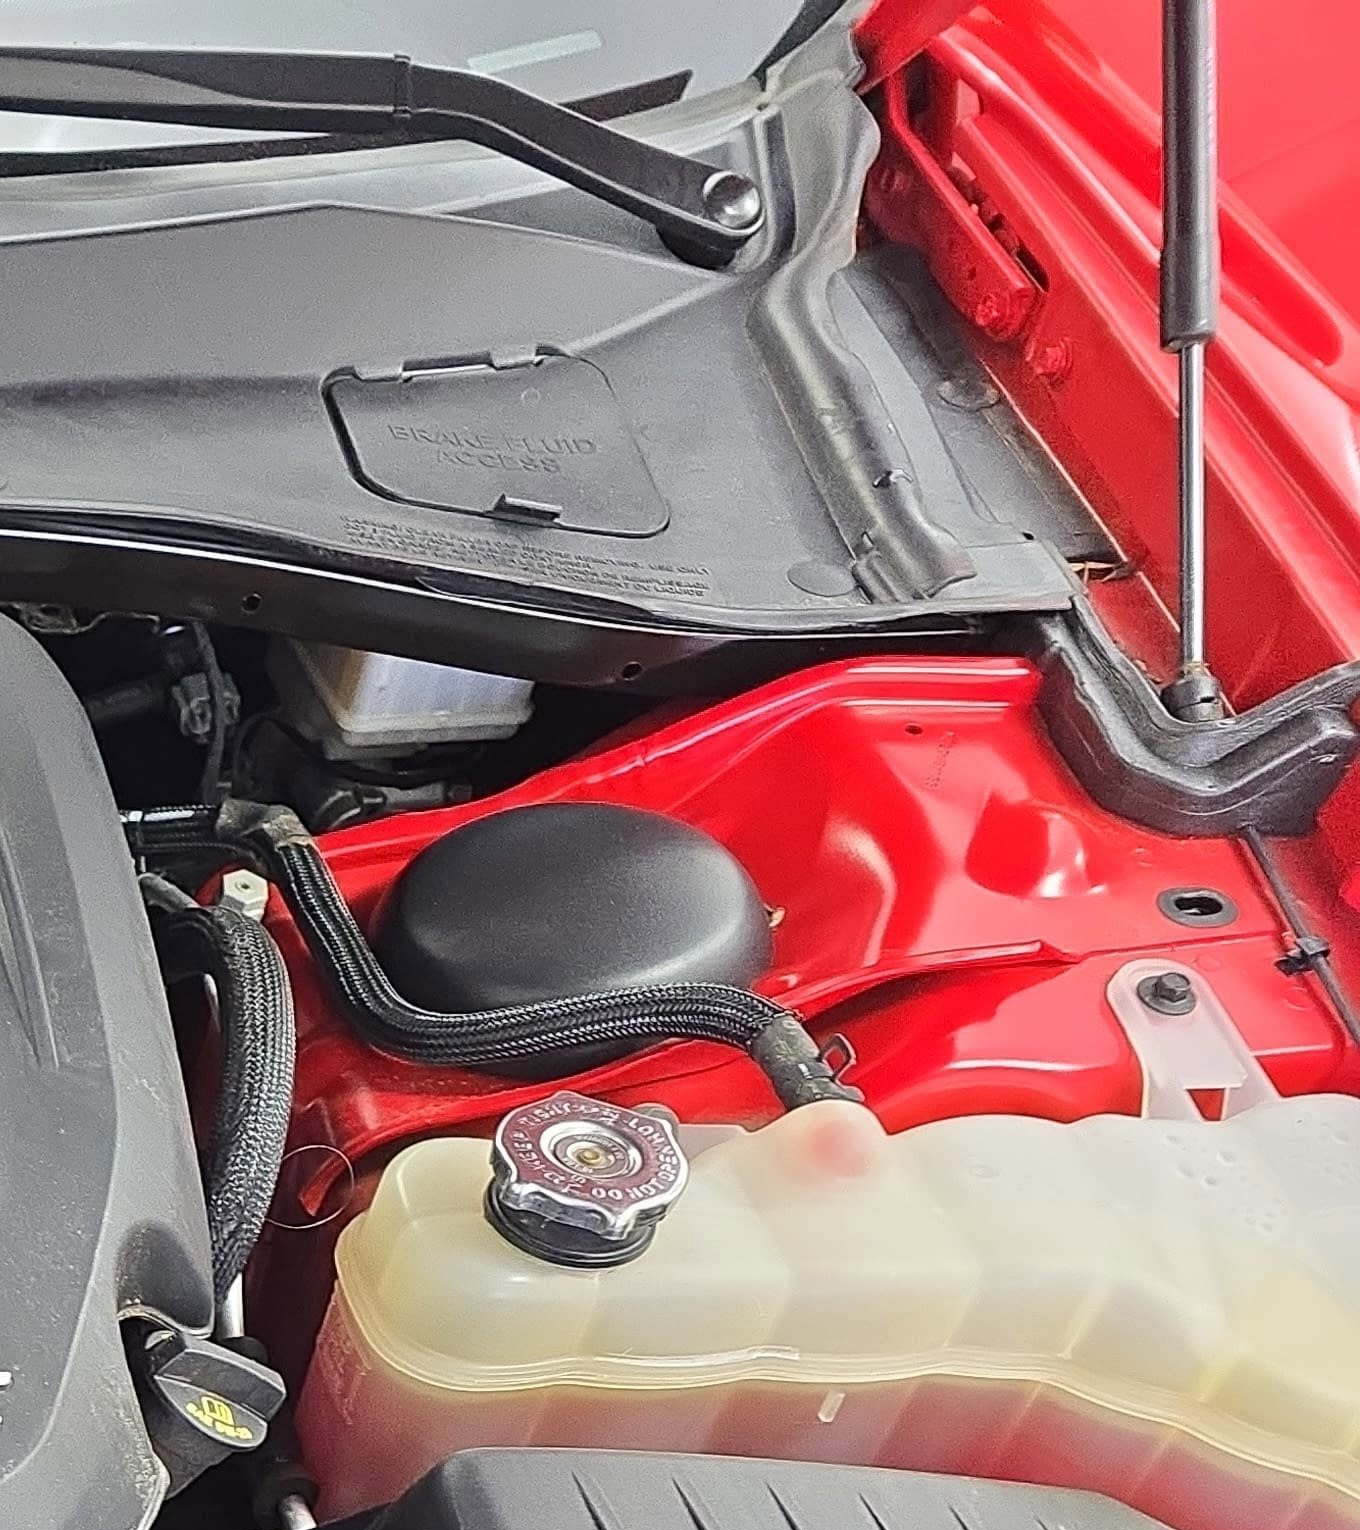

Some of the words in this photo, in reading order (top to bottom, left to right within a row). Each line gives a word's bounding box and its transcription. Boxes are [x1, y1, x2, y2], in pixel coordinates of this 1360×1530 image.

[628, 1117, 667, 1147] HOT
[591, 1186, 624, 1201] DO
[628, 1177, 663, 1201] NOT
